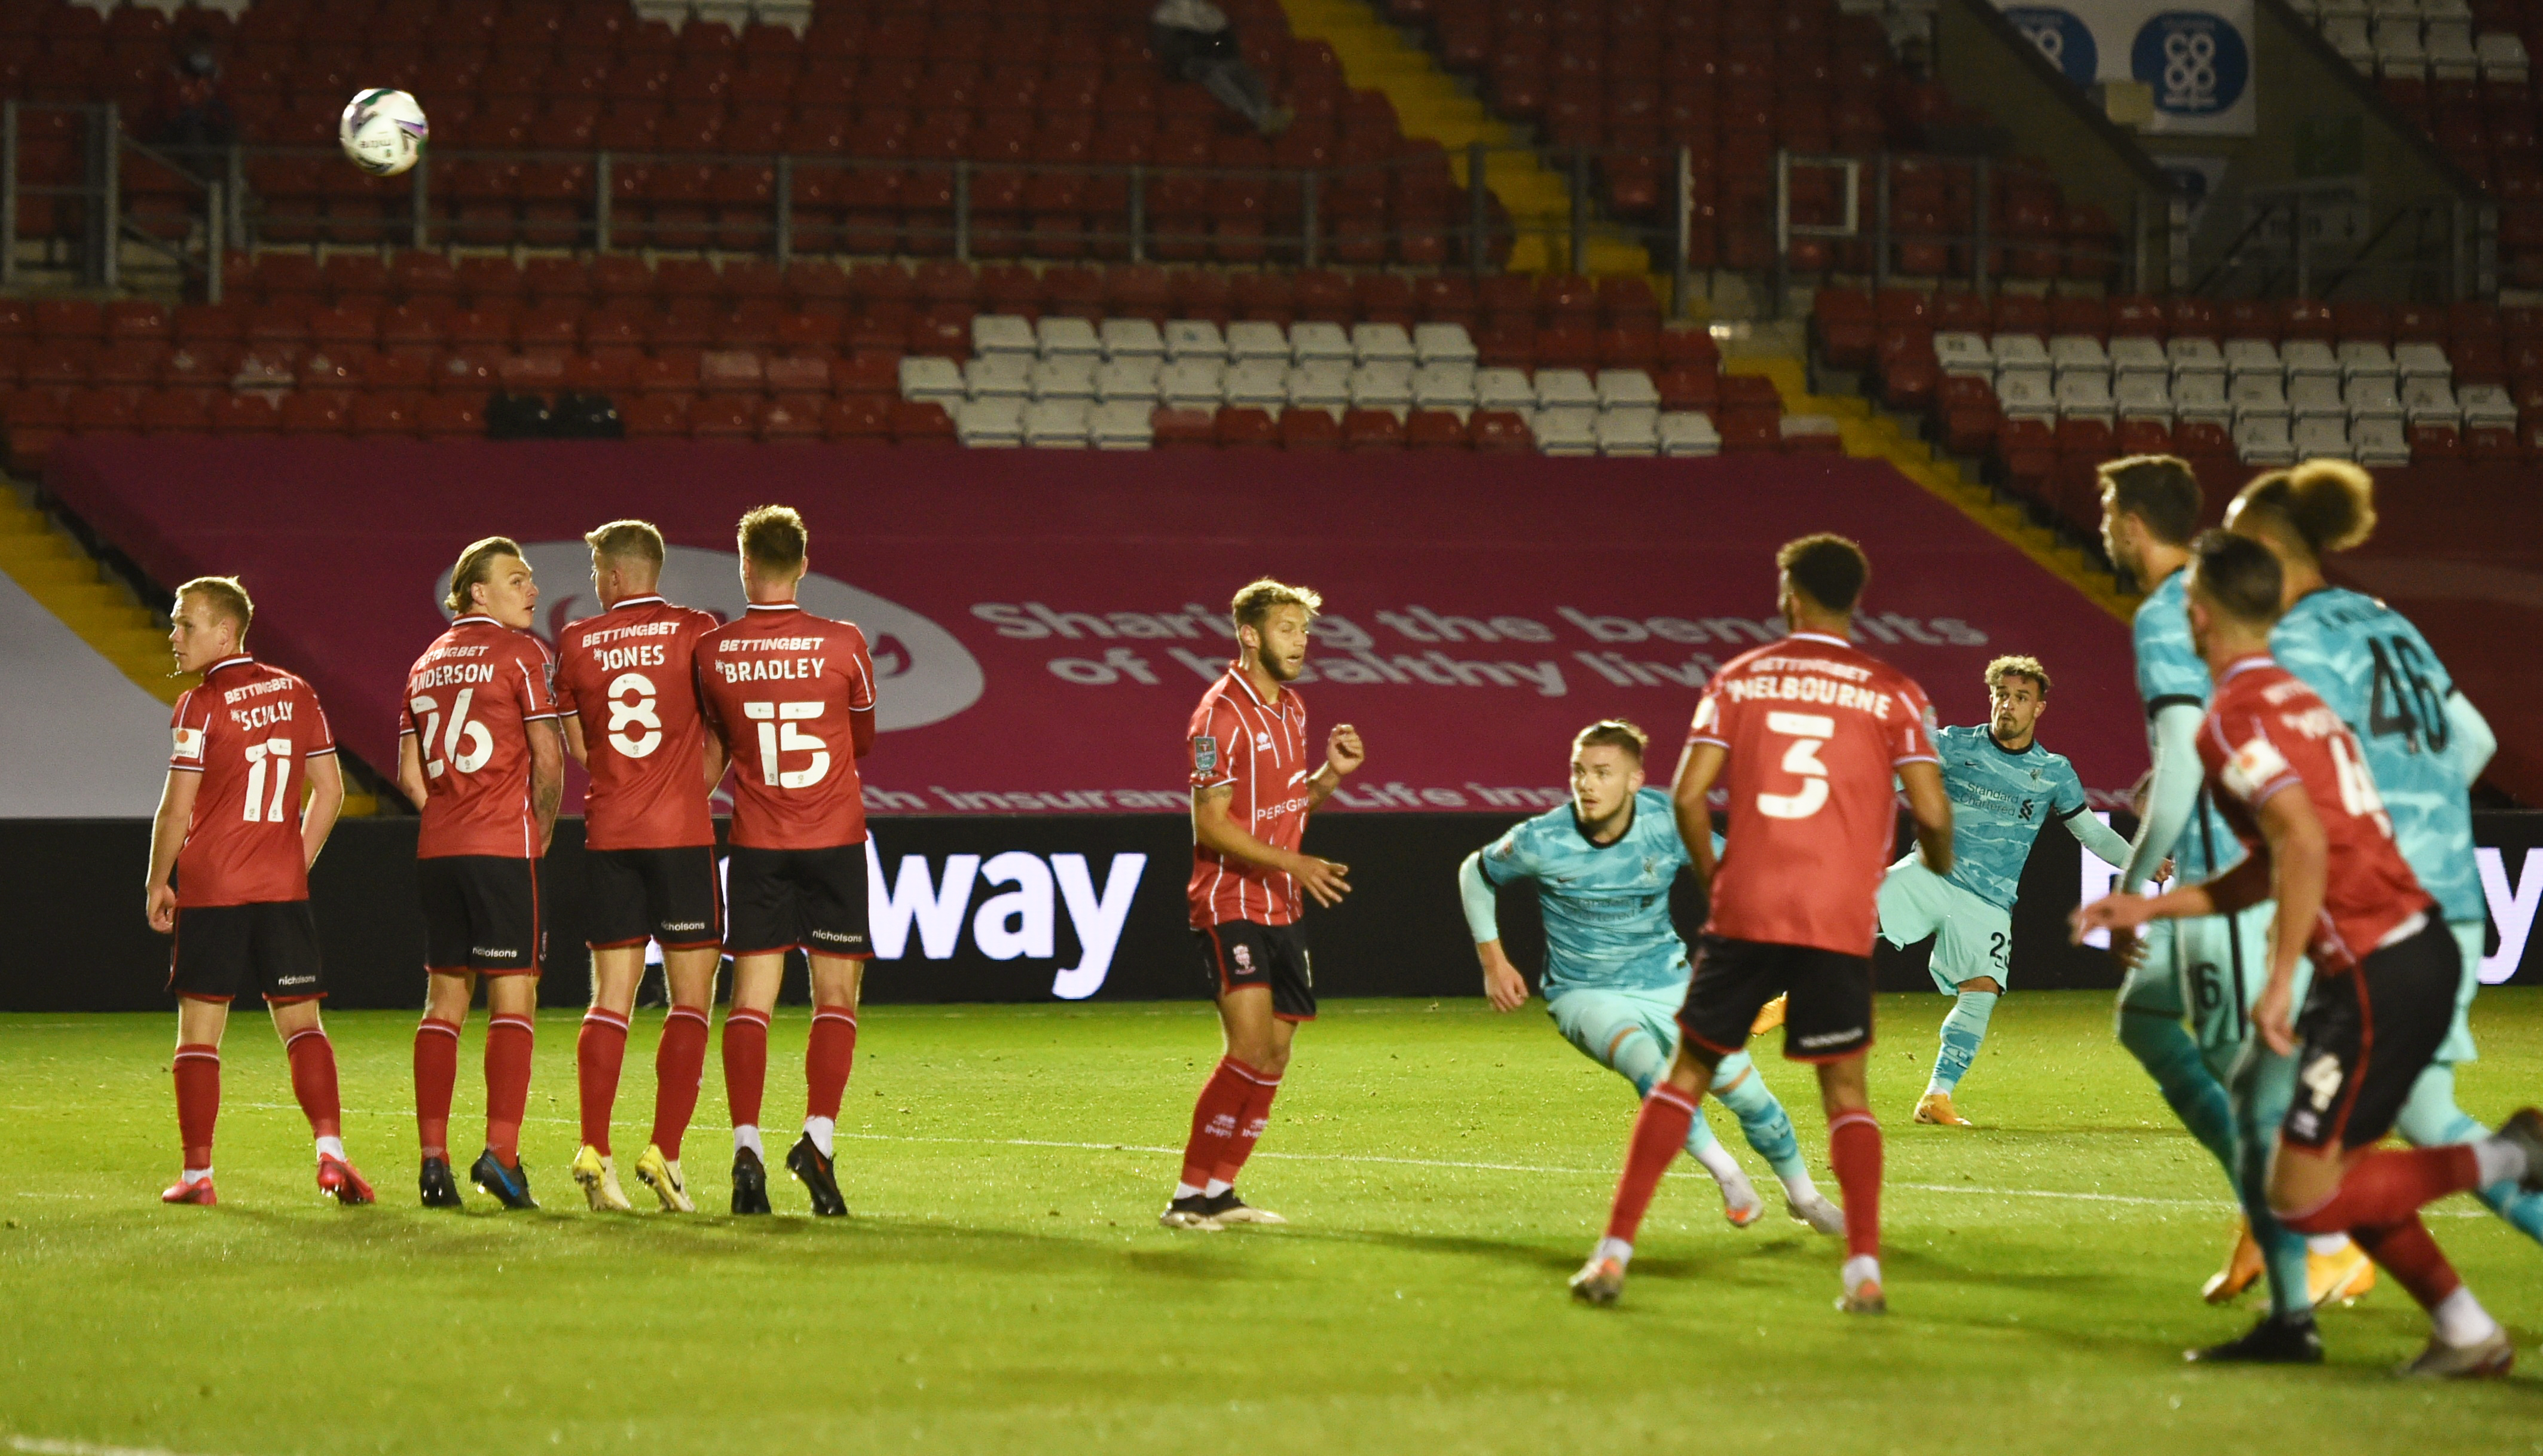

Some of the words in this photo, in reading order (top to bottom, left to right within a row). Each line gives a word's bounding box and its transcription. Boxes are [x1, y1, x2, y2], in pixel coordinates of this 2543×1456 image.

[582, 622, 680, 648] BETTINGBET
[970, 602, 1374, 650] Sharig
[1376, 604, 1555, 643] the
[1556, 606, 1989, 646] benits
[601, 645, 665, 671] JONES
[719, 638, 824, 652] BETTINGBET
[411, 663, 494, 696] ANDERSON
[725, 658, 824, 683] BRADLEY
[1047, 646, 1161, 685] of
[1572, 650, 1723, 688] livi
[224, 678, 292, 705] BETTINGBET
[1729, 676, 1891, 720] MELBOURNE
[2367, 634, 2449, 755] 46
[241, 701, 293, 731] SCULLY
[607, 673, 662, 758] 8
[409, 688, 494, 779] 26
[743, 702, 830, 789] 15
[243, 738, 292, 822] 11
[1756, 710, 1835, 820] 3
[928, 785, 1191, 810] insuran
[1960, 793, 2016, 816] Chartered
[1967, 782, 2019, 803] Standard
[812, 929, 863, 943] nicholsons
[278, 974, 316, 986] nicholsons
